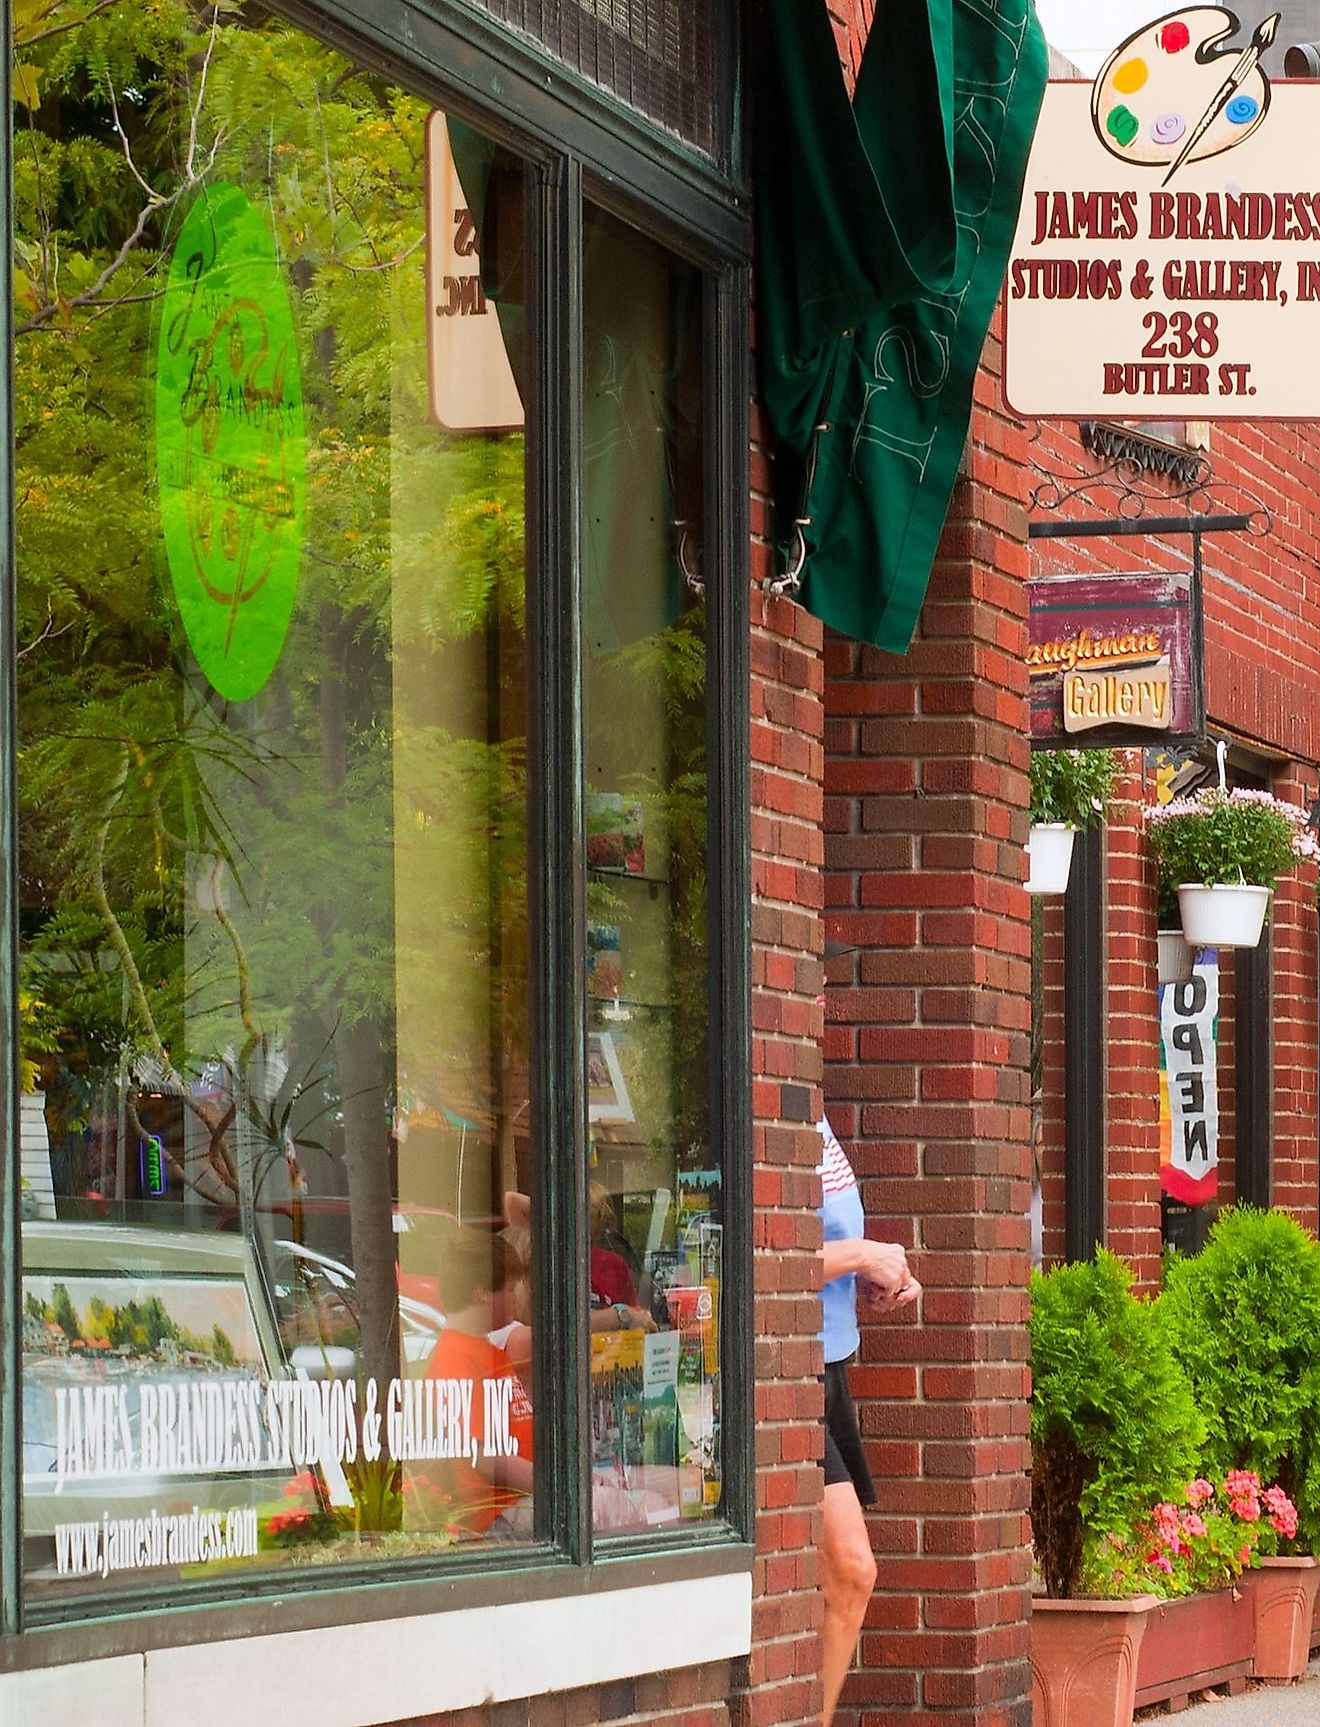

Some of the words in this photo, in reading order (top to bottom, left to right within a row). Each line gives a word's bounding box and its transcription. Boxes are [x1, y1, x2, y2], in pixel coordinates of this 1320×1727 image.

[1031, 191, 1138, 246] JAMES
[1011, 258, 1123, 300] STUDIOS
[1130, 258, 1154, 300] &
[1162, 259, 1288, 307] GALLERY,
[1141, 311, 1219, 358] 238
[1103, 363, 1209, 395] BUTLER
[1219, 363, 1256, 395] ST.
[1025, 627, 1162, 671] aughman
[1067, 675, 1167, 722] Gallery
[54, 1384, 132, 1496] JAMES
[139, 1378, 261, 1473] BRANDESS
[267, 1377, 357, 1468] STUDIOS
[363, 1377, 382, 1462] &
[387, 1377, 478, 1469] GALLERY,
[483, 1377, 519, 1457] INC.
[54, 1504, 259, 1580] www.jamesbrandess.com
